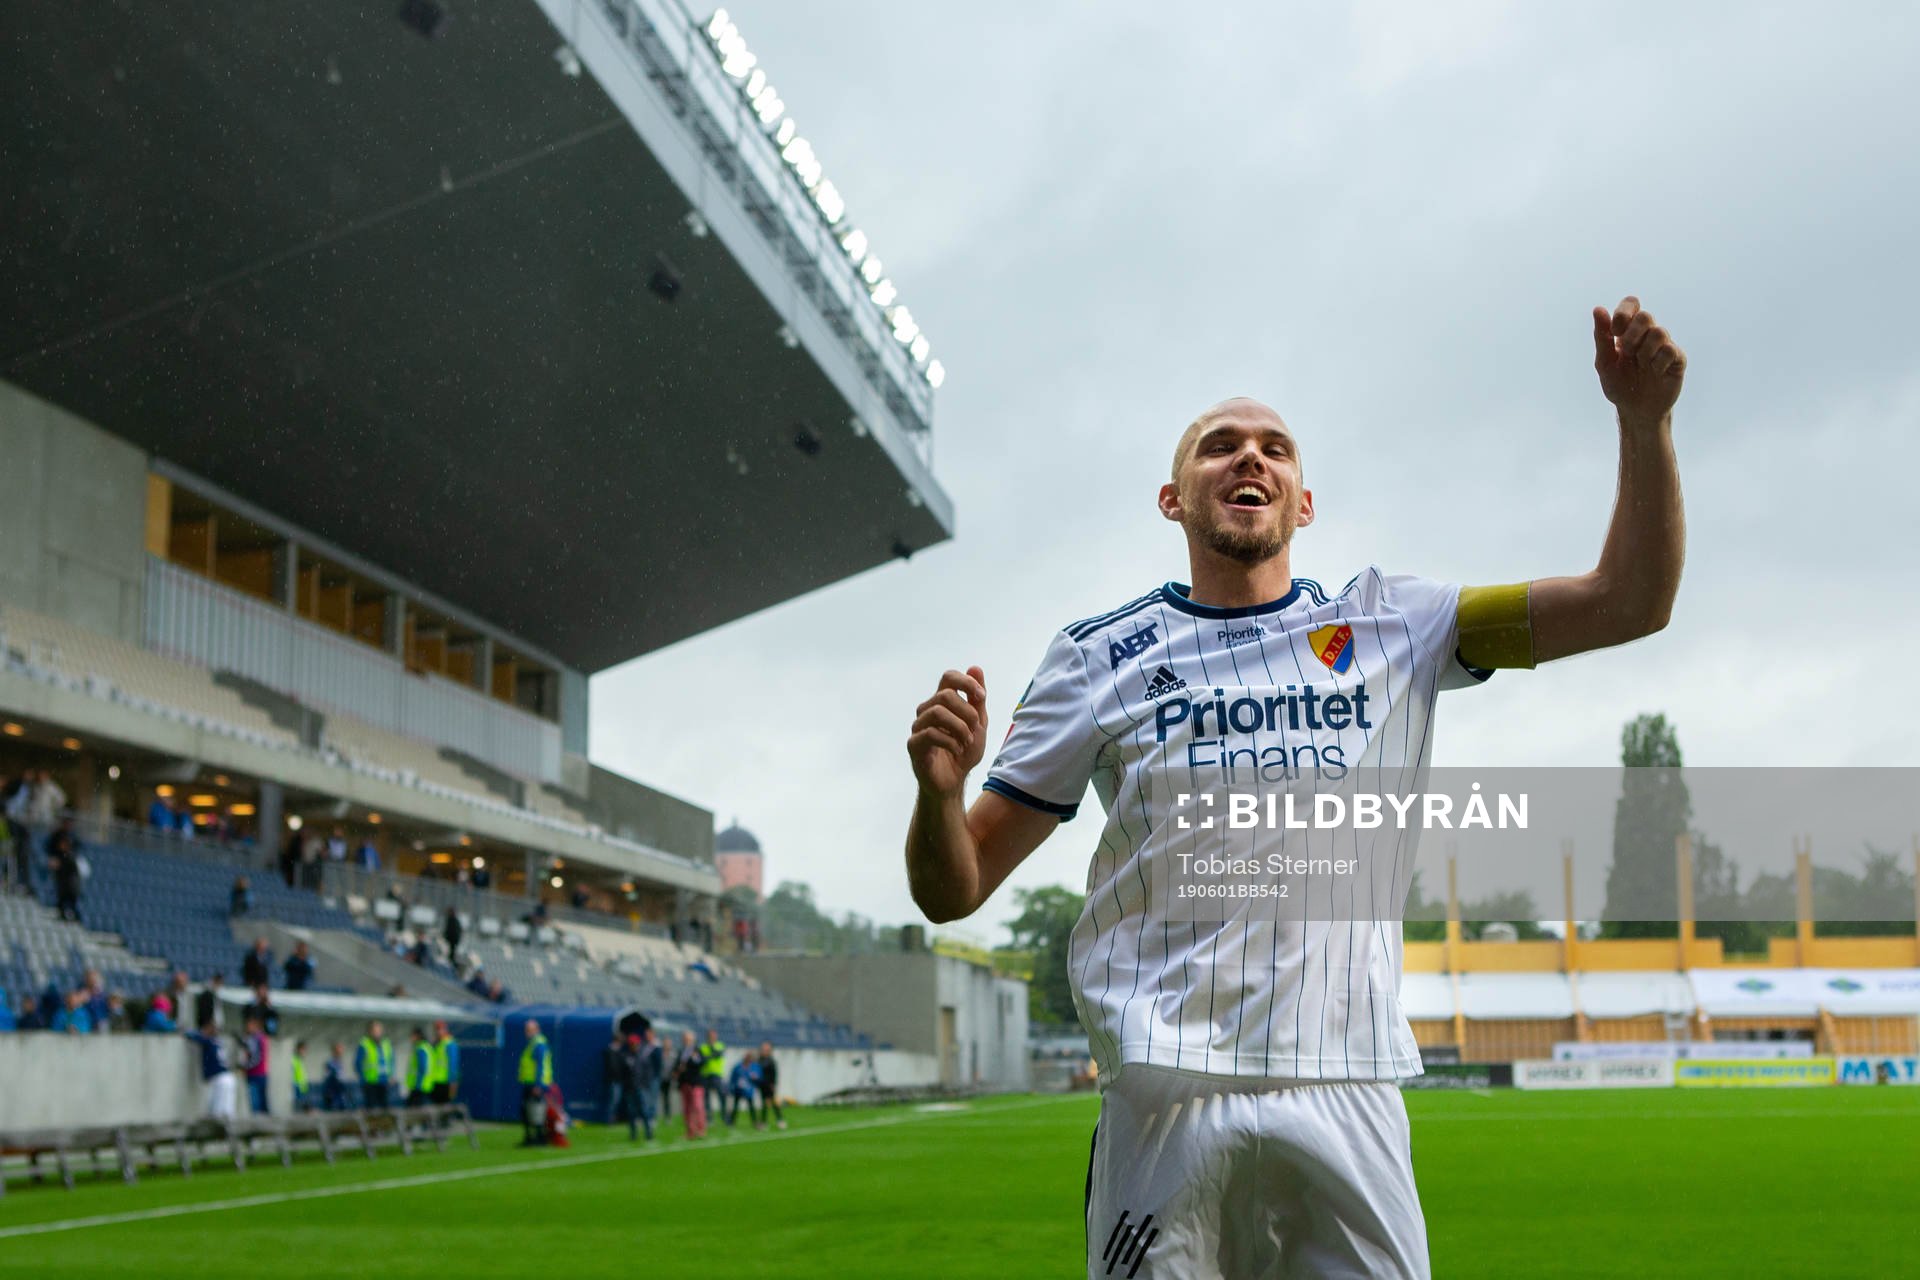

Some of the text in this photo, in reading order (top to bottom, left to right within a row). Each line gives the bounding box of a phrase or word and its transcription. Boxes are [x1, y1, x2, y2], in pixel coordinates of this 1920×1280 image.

[1109, 622, 1159, 671] ABT
[1217, 626, 1266, 642] Prioritet
[1324, 631, 1350, 662] D.I.F.
[1144, 679, 1187, 701] adidas
[1156, 685, 1372, 743] Prioritet
[1187, 739, 1349, 788] Finans
